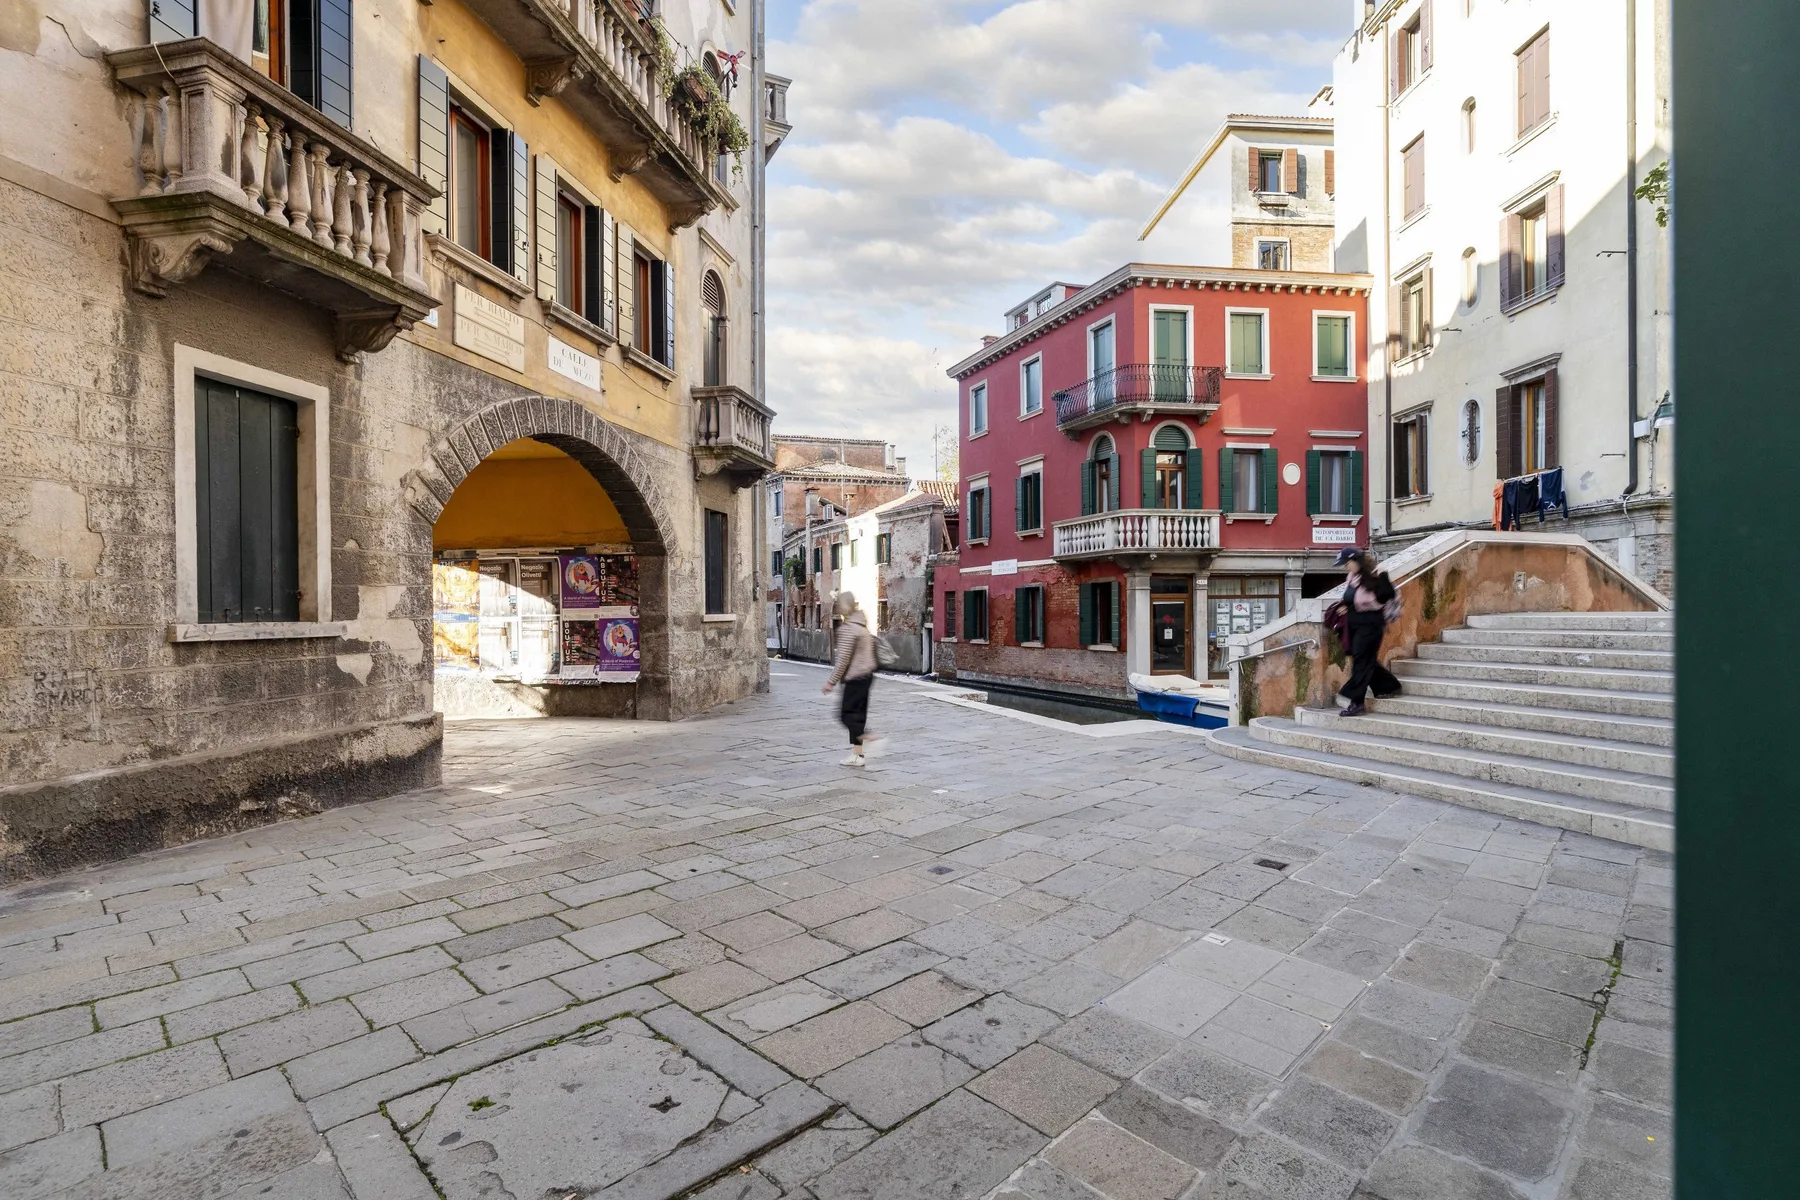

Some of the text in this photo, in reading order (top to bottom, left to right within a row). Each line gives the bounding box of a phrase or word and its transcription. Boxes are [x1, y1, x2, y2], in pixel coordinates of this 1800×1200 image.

[464, 288, 519, 325] PER RIALTO
[460, 319, 480, 337] PER
[561, 348, 588, 369] CALLE
[553, 355, 594, 382] DE MEZO
[601, 590, 606, 602] US
[565, 649, 571, 662] US
